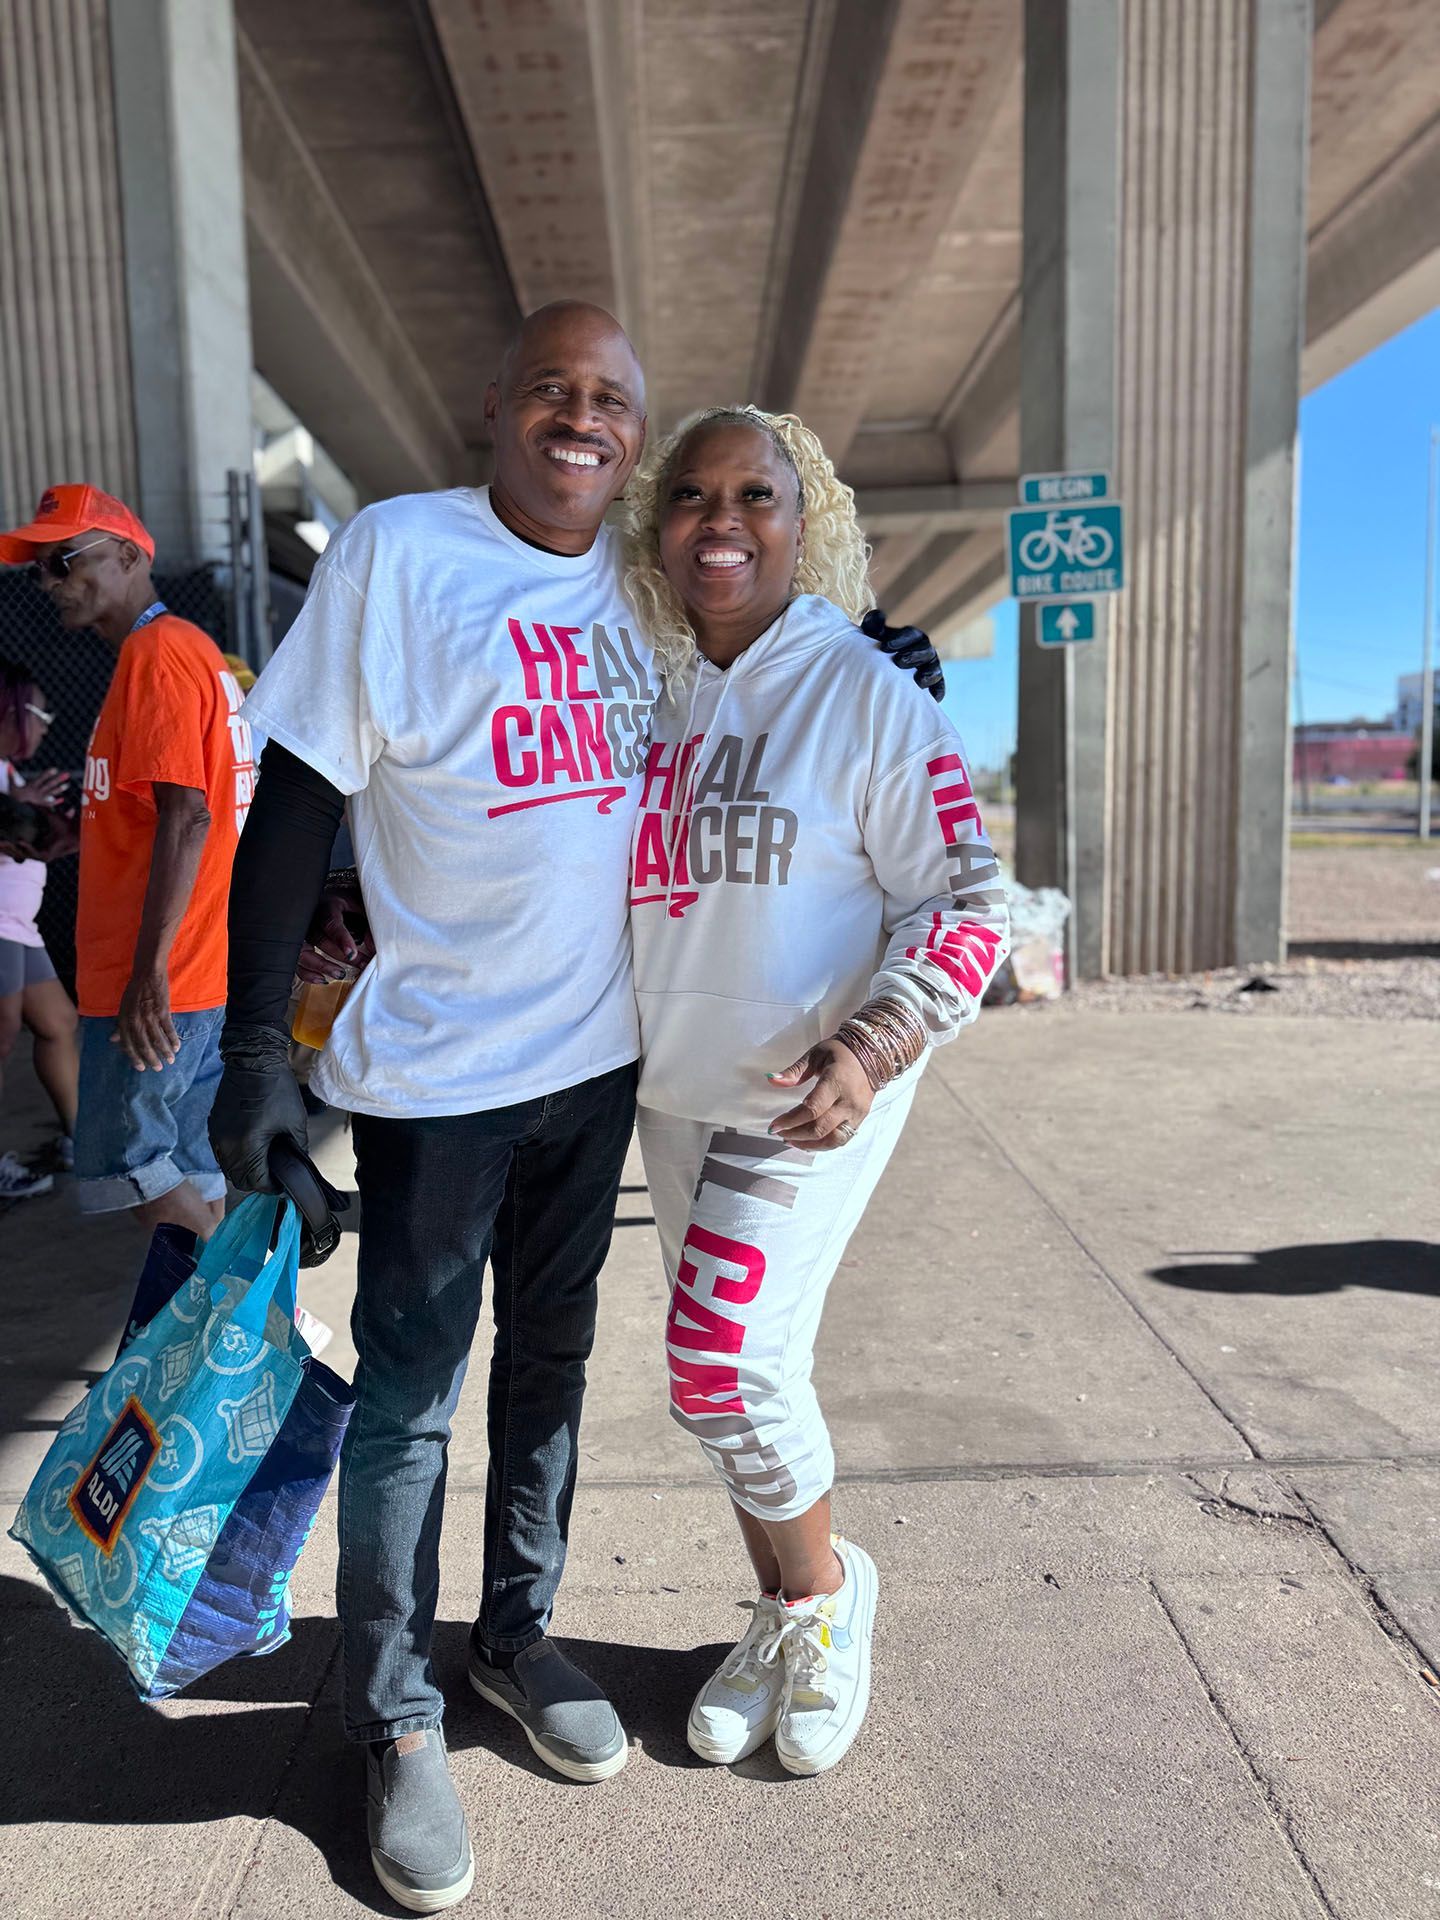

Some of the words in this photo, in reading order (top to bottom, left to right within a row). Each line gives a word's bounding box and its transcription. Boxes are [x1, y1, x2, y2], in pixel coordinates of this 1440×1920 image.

[1038, 478, 1093, 498] BEGIN
[1017, 572, 1053, 595] BIKE
[1060, 568, 1118, 591] ROUTE
[491, 702, 655, 788] CANCE
[86, 1472, 120, 1524] ALDI
